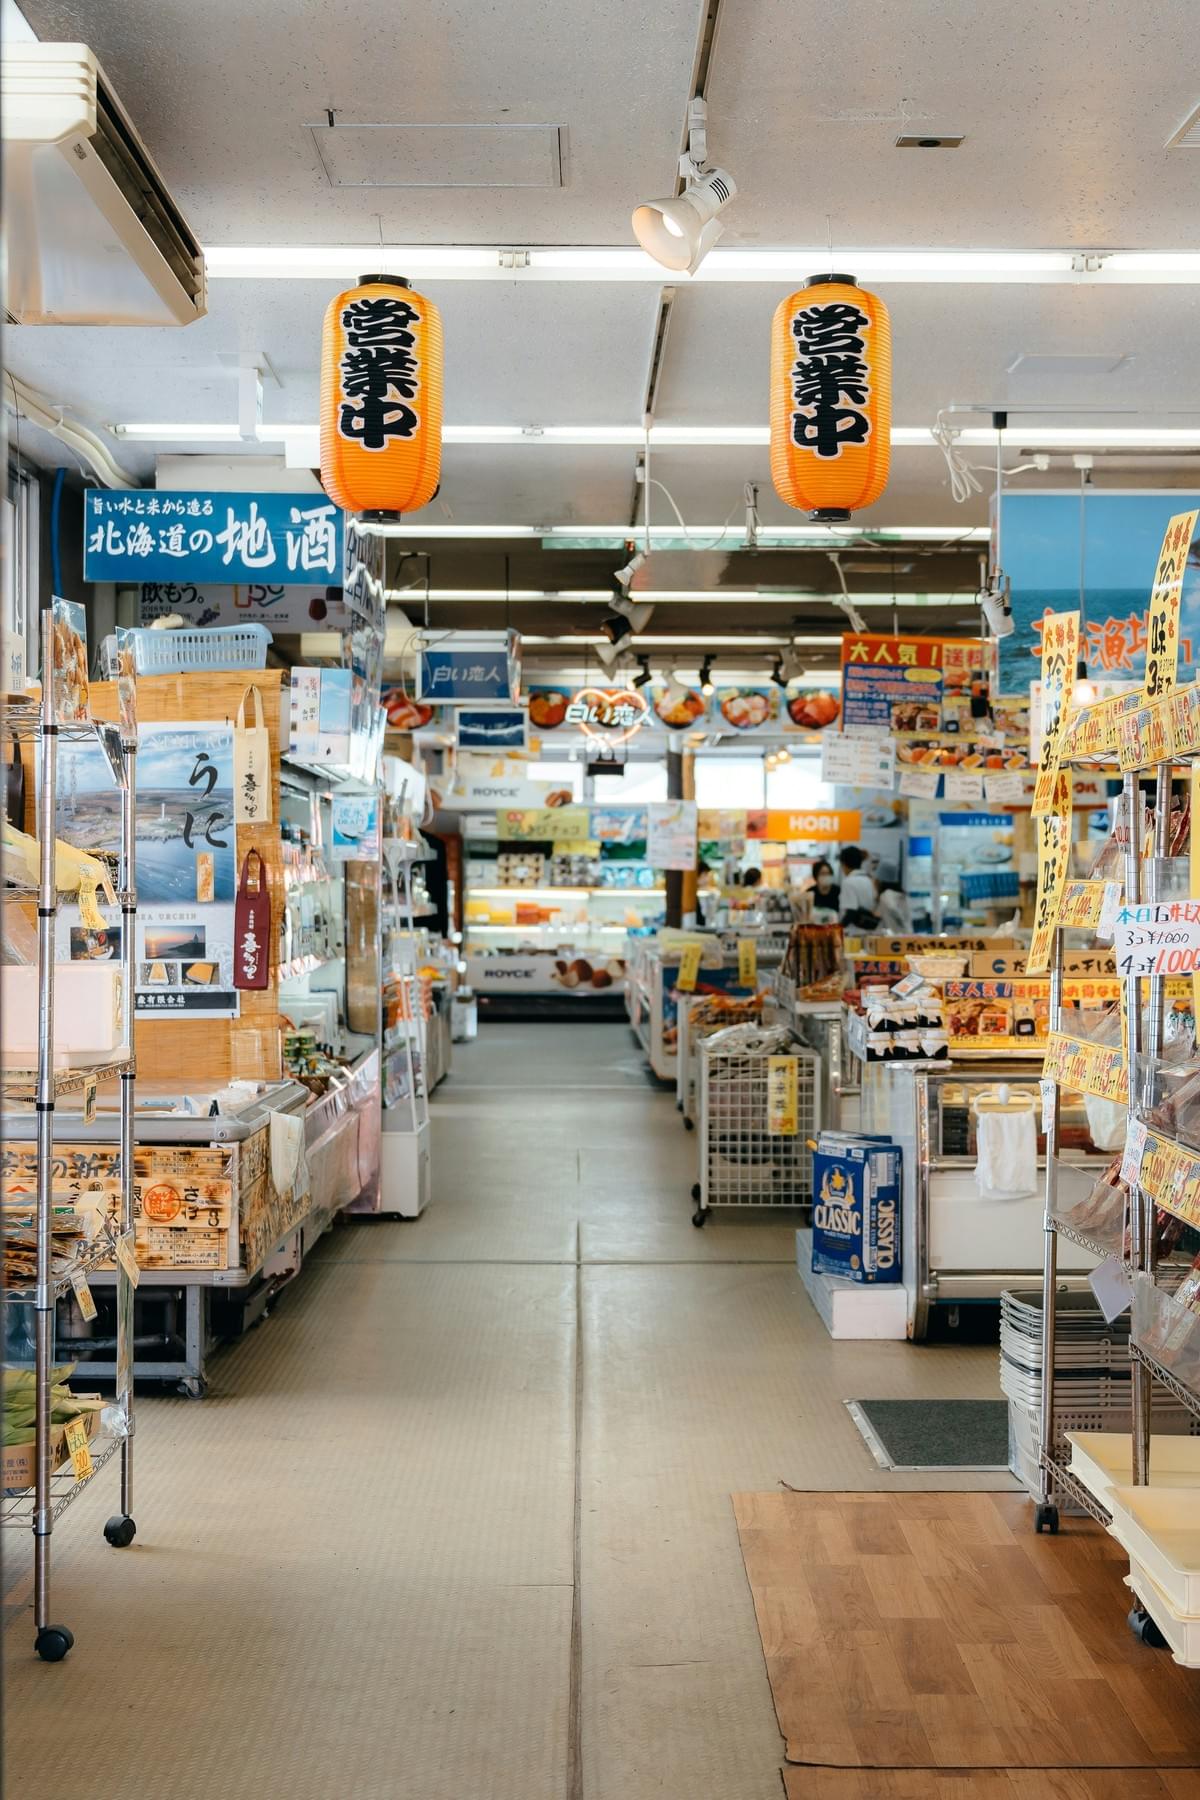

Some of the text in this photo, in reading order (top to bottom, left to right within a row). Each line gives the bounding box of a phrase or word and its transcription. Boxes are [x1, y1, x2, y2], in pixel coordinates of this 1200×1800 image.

[341, 298, 421, 450] 営業中
[791, 303, 870, 457] 営業中
[92, 496, 214, 516] 旨い水と米から造る
[87, 502, 338, 574] 北海道の地酒
[433, 664, 502, 683] 白い恋人
[564, 703, 654, 726] 白い恋人
[183, 752, 229, 849] うに
[789, 815, 840, 833] HORI
[814, 1204, 861, 1236] CLASSIC
[877, 1199, 896, 1269] CLASSIC
